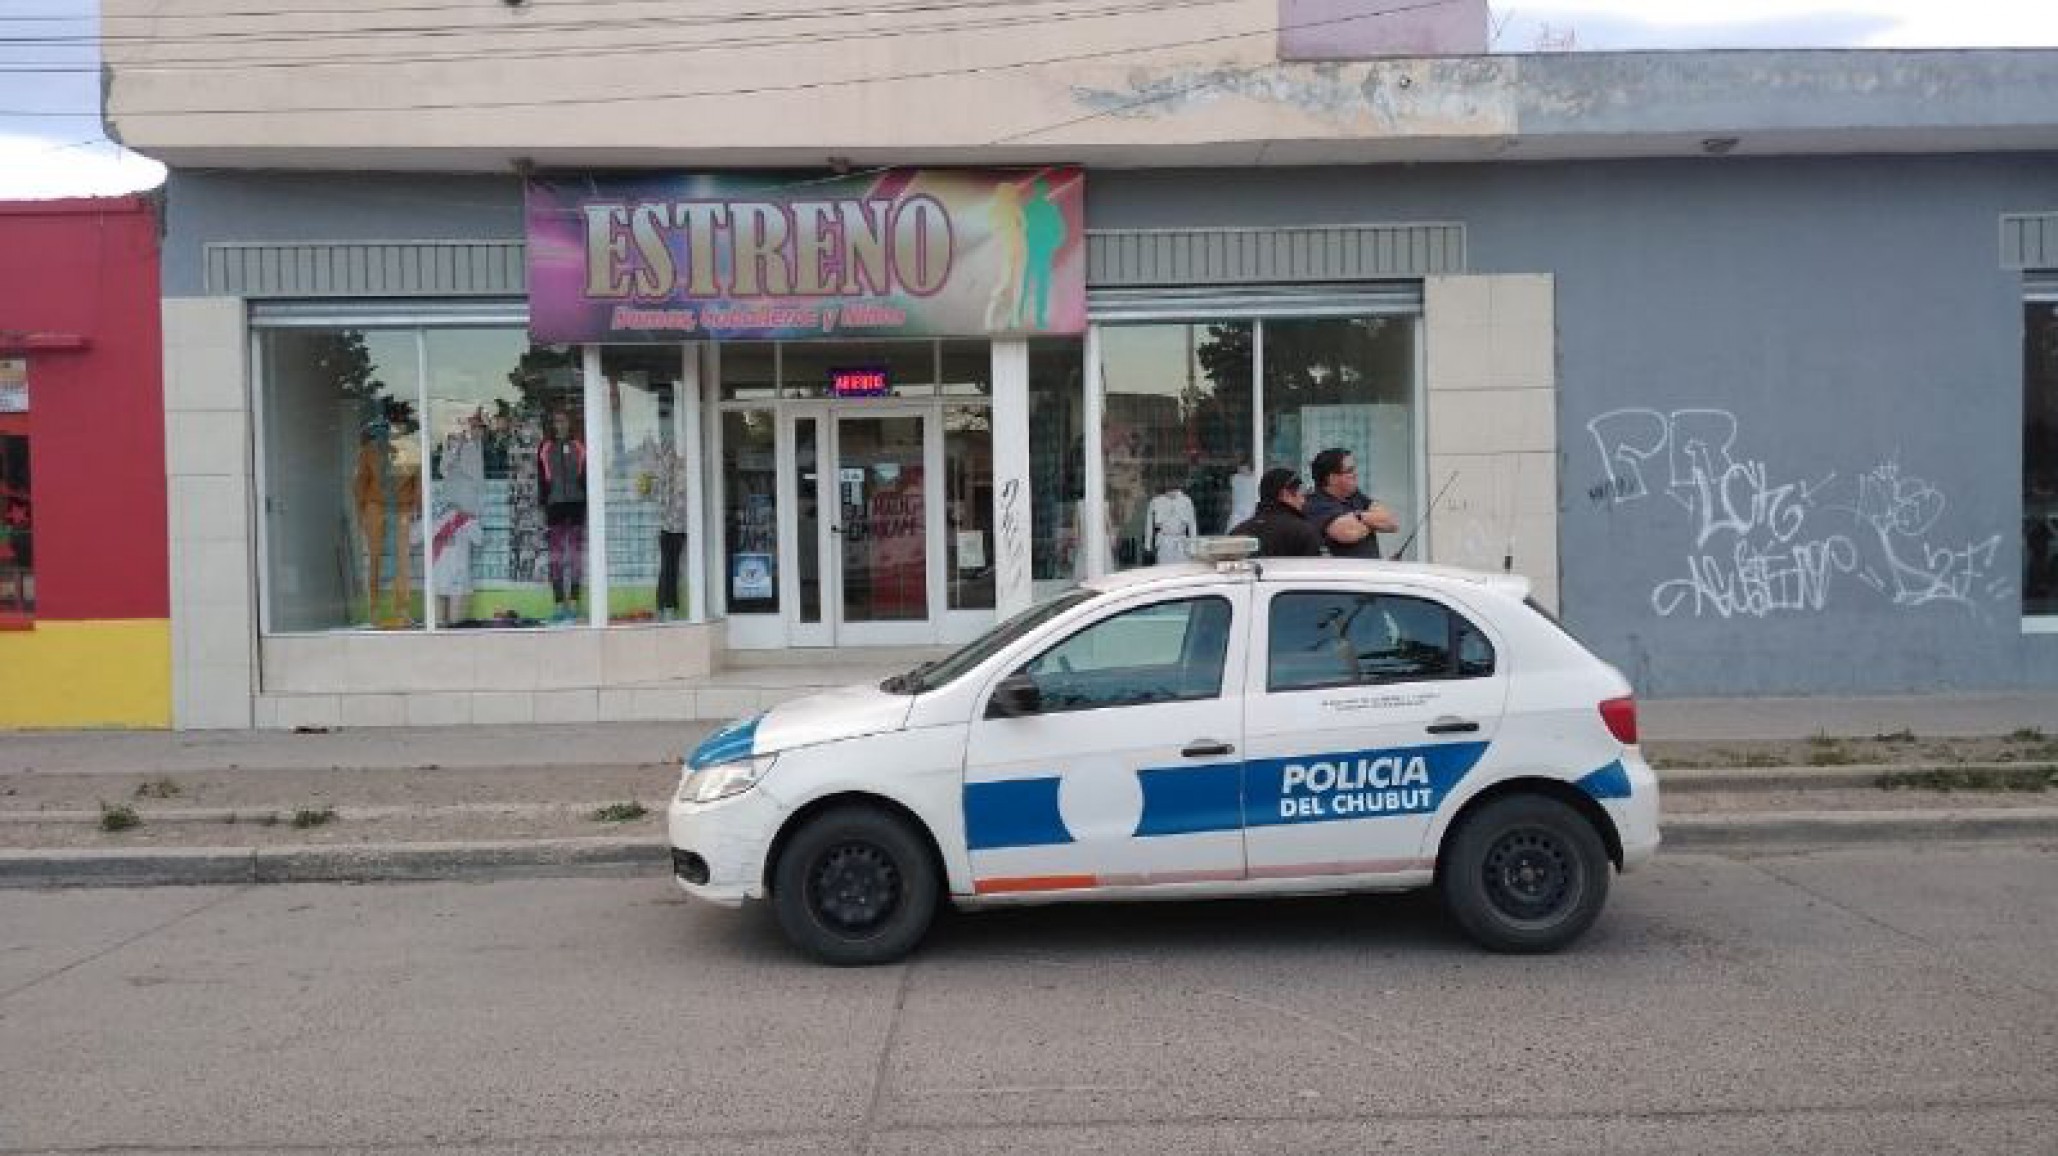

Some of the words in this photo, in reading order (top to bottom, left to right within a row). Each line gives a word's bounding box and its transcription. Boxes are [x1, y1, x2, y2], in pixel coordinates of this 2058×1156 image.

[585, 193, 953, 299] ESTRENO
[1281, 756, 1429, 794] POLICIA
[1280, 797, 1325, 818] DEL
[1332, 788, 1433, 815] CHUBUT
